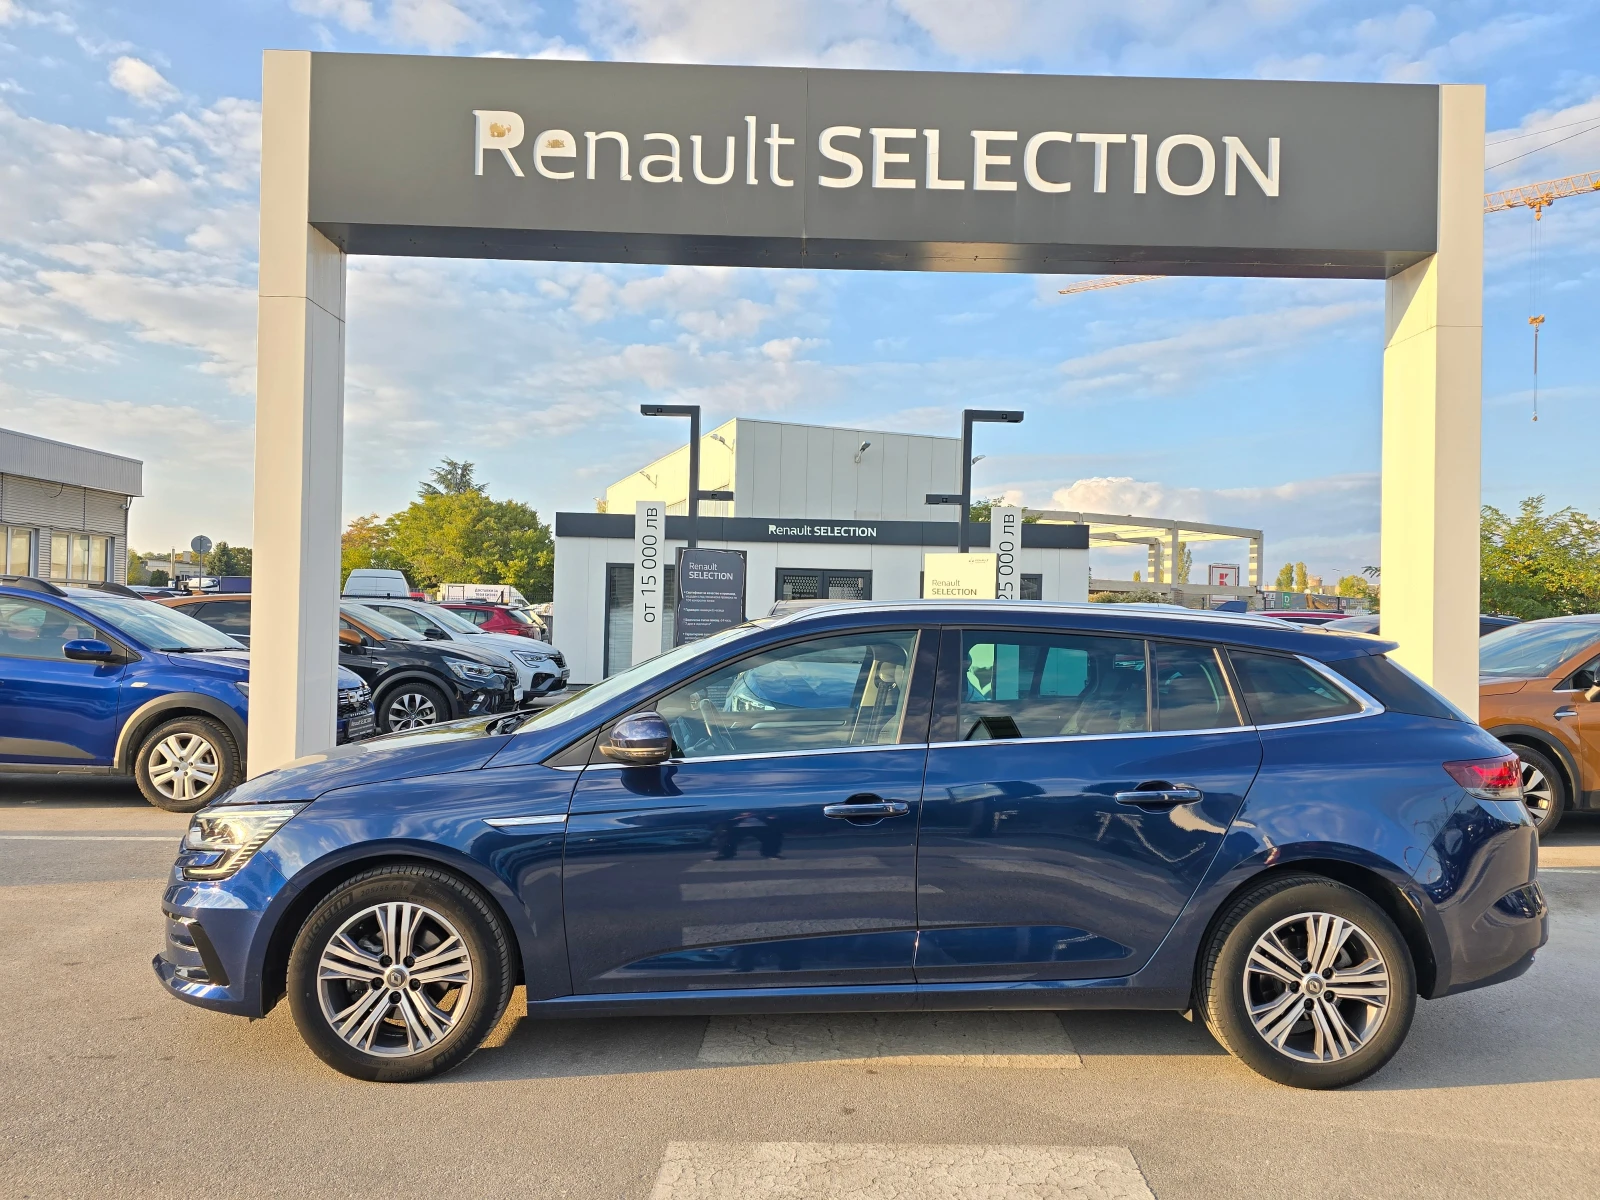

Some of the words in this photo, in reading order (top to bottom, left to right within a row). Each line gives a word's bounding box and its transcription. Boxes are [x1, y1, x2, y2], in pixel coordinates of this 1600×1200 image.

[472, 108, 795, 188] Renault
[817, 125, 1281, 198] SELECTION
[768, 524, 812, 536] Renault
[813, 526, 877, 537] SELECTION
[641, 534, 657, 570] 000
[998, 541, 1014, 576] 000
[689, 562, 718, 571] Renault
[688, 571, 733, 581] SELECTION
[931, 579, 960, 587] Renault
[641, 575, 657, 596] 15
[931, 588, 977, 596] SELECTION
[303, 896, 351, 952] MICHELIN
